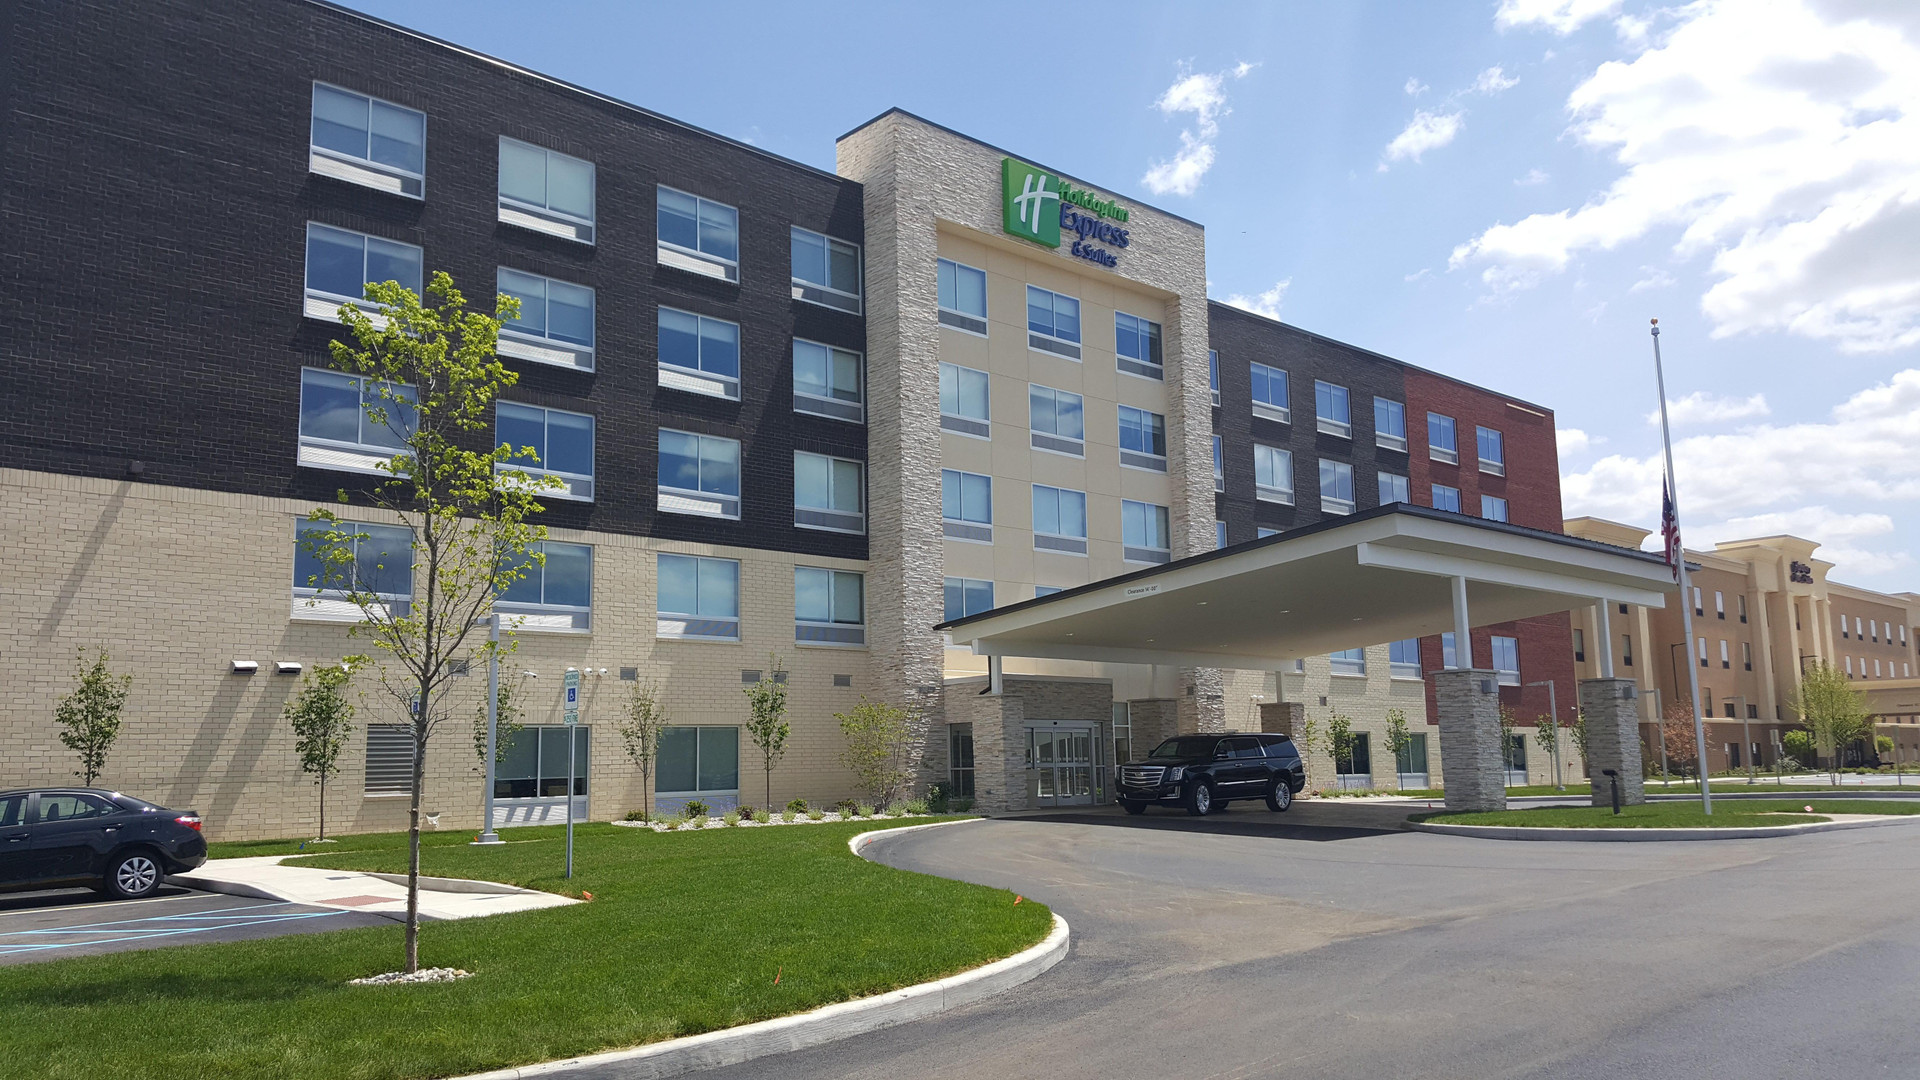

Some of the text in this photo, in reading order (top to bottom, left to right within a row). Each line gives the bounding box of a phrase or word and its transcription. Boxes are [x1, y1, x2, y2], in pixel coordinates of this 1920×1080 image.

[1058, 181, 1130, 222] Holiday Inn
[1059, 202, 1130, 248] Express
[1071, 241, 1118, 268] & Suites
